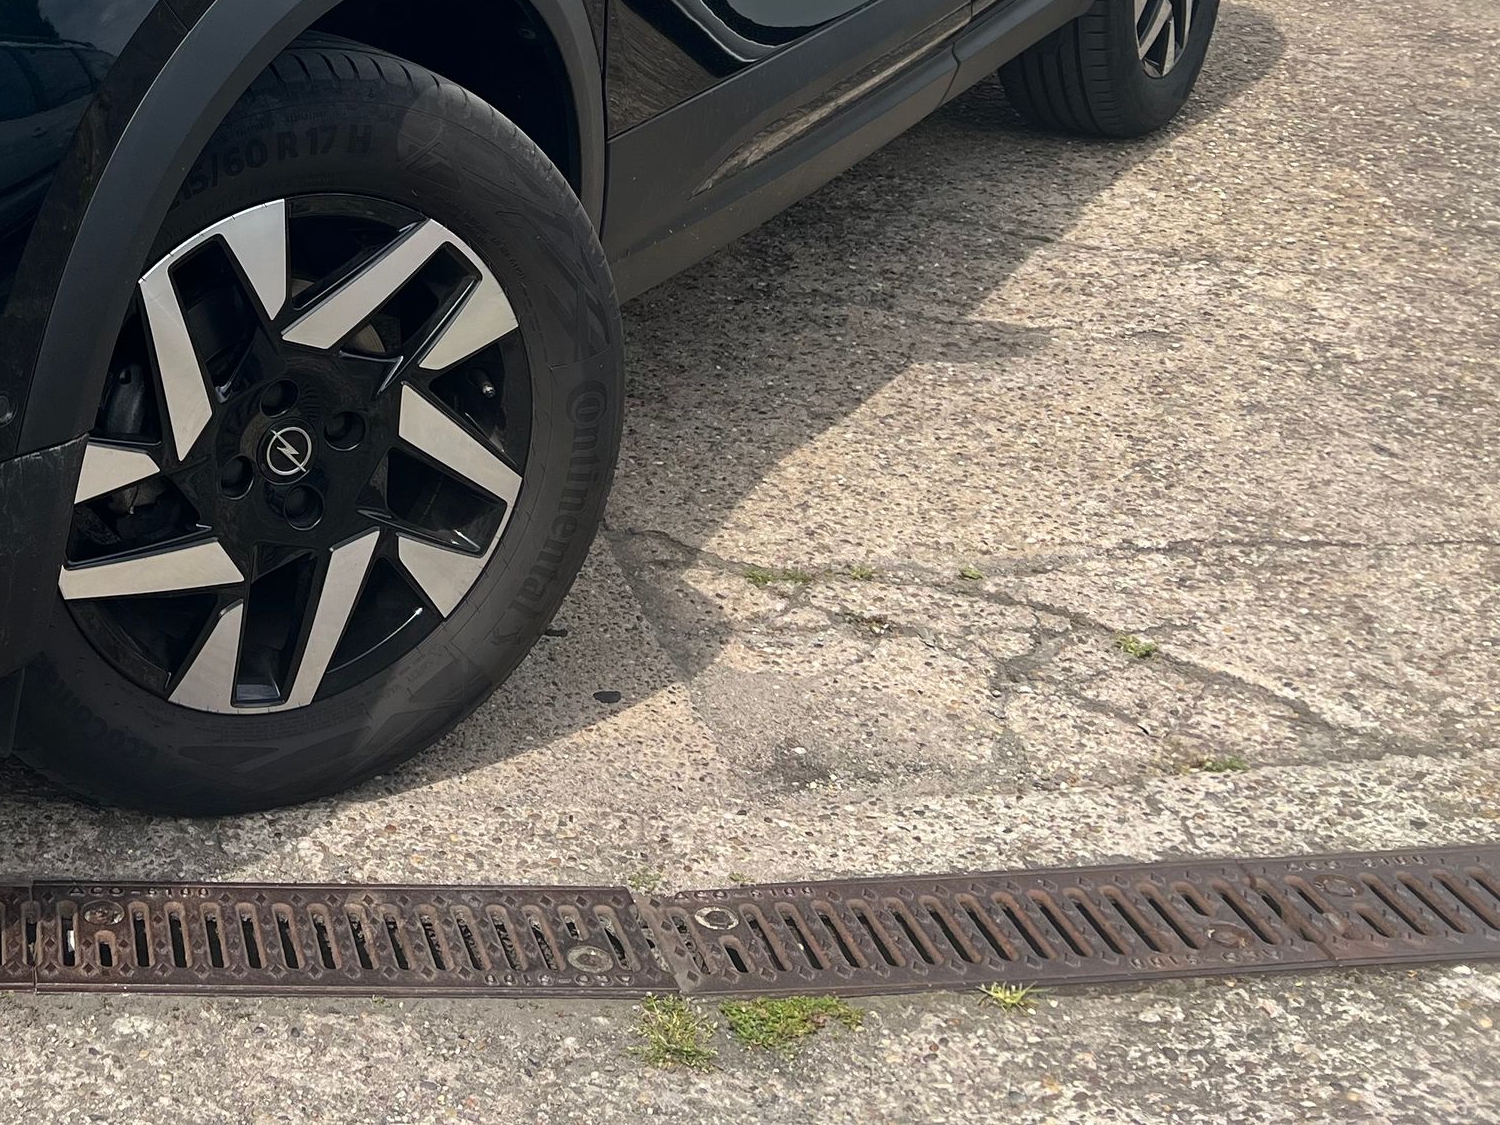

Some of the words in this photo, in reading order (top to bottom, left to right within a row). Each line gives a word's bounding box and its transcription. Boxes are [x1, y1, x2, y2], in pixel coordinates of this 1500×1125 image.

[276, 129, 299, 161] R
[306, 123, 338, 156] 17
[348, 123, 373, 155] H
[508, 379, 609, 622] Continental
